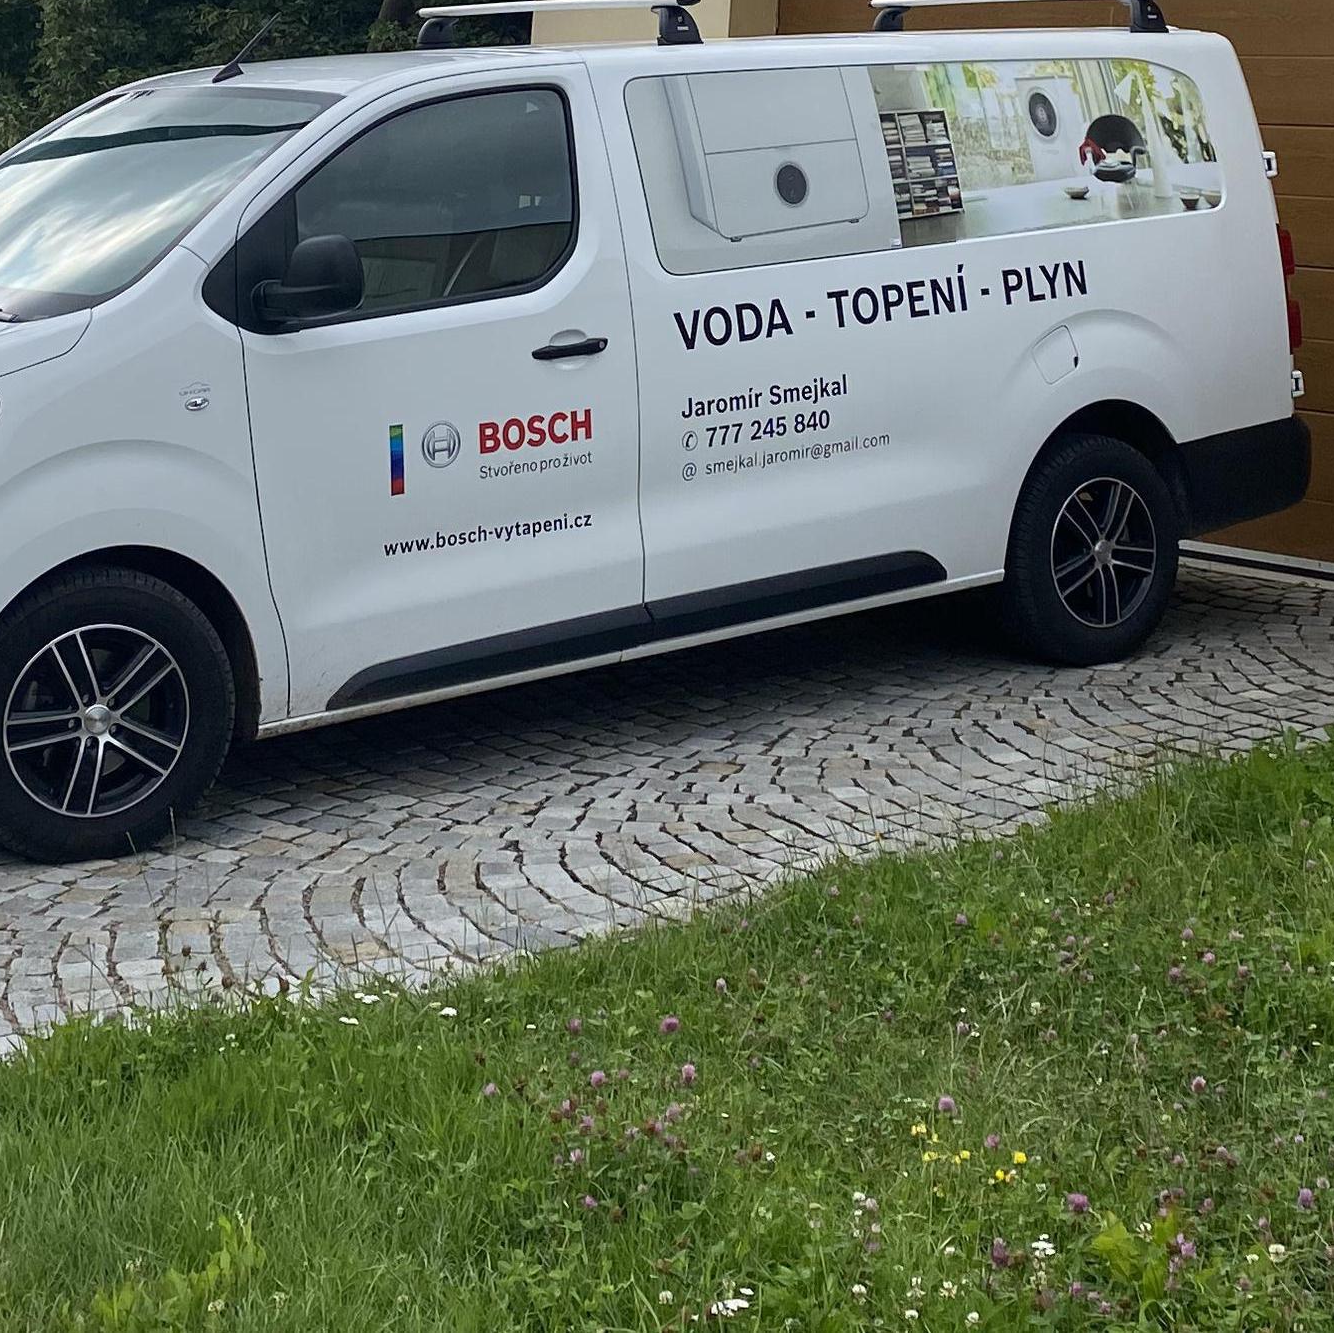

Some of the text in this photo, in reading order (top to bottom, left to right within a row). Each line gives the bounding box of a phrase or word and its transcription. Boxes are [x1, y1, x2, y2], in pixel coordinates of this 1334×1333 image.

[672, 297, 794, 352] VODA
[826, 264, 969, 329] TOPENÍ
[1001, 258, 1089, 306] PLYN
[681, 373, 848, 419] Jaromír Smejkal
[478, 408, 593, 455] BOSCH
[705, 409, 831, 448] 777 245 840
[479, 451, 593, 480] Stvořeno pro život
[705, 432, 891, 475] smejkal.jaromir@gmail.com
[383, 513, 592, 556] www.bosch-vytapeni.cz
